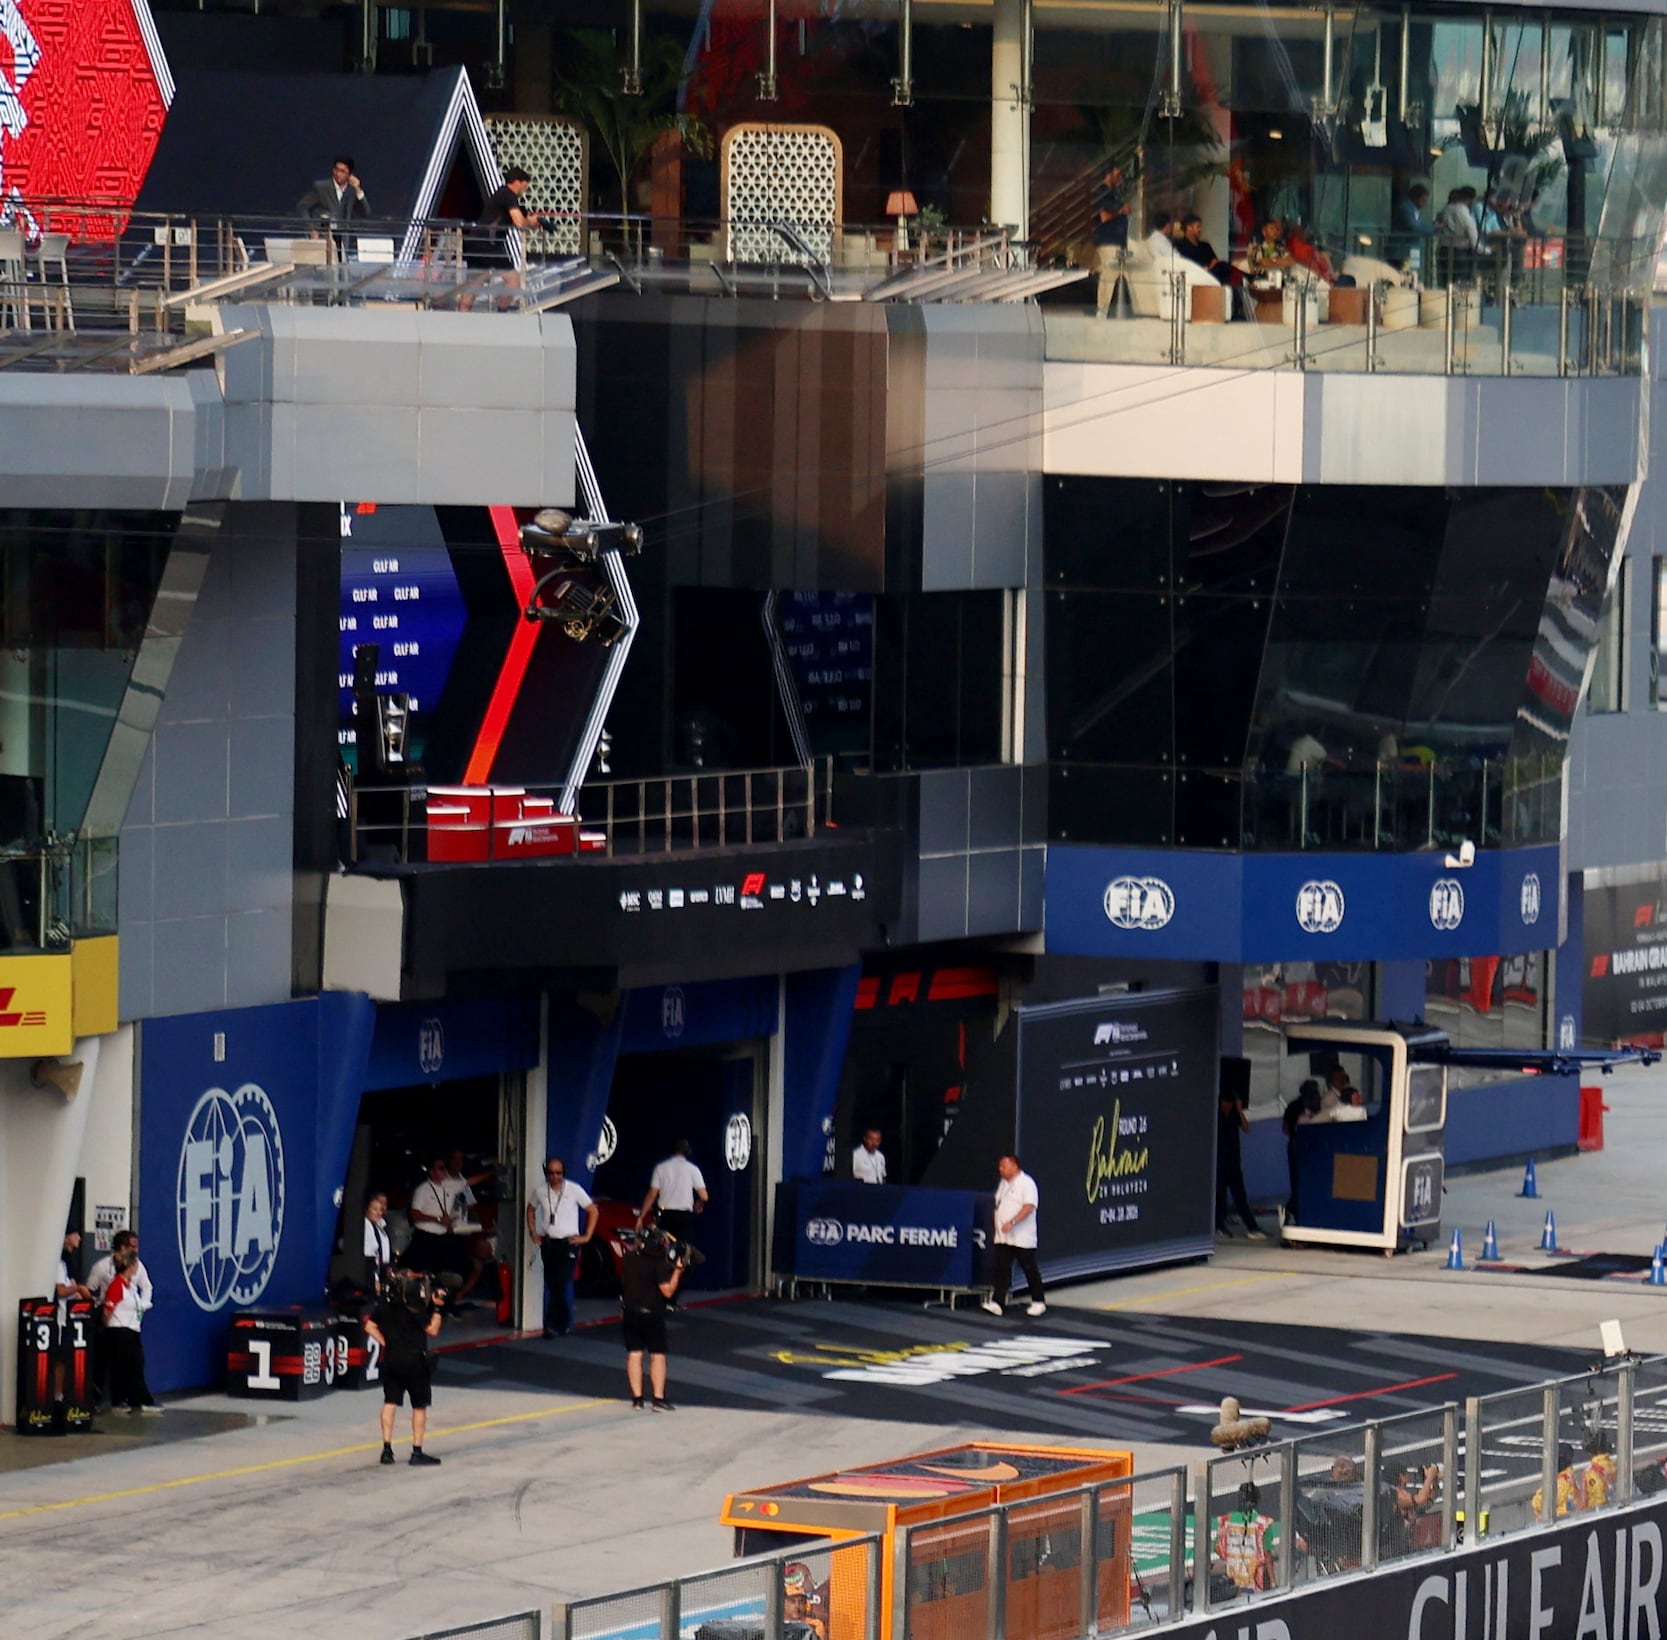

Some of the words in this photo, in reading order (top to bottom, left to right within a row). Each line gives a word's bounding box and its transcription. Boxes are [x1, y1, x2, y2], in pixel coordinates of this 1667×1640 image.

[1612, 948, 1648, 976] BAHRAIN
[1086, 1098, 1149, 1204] Bahrain
[847, 1223, 895, 1244] PARC
[900, 1226, 958, 1248] FERMÉ
[36, 1324, 50, 1351] 3
[73, 1322, 86, 1348] 1
[247, 1340, 281, 1390] 1
